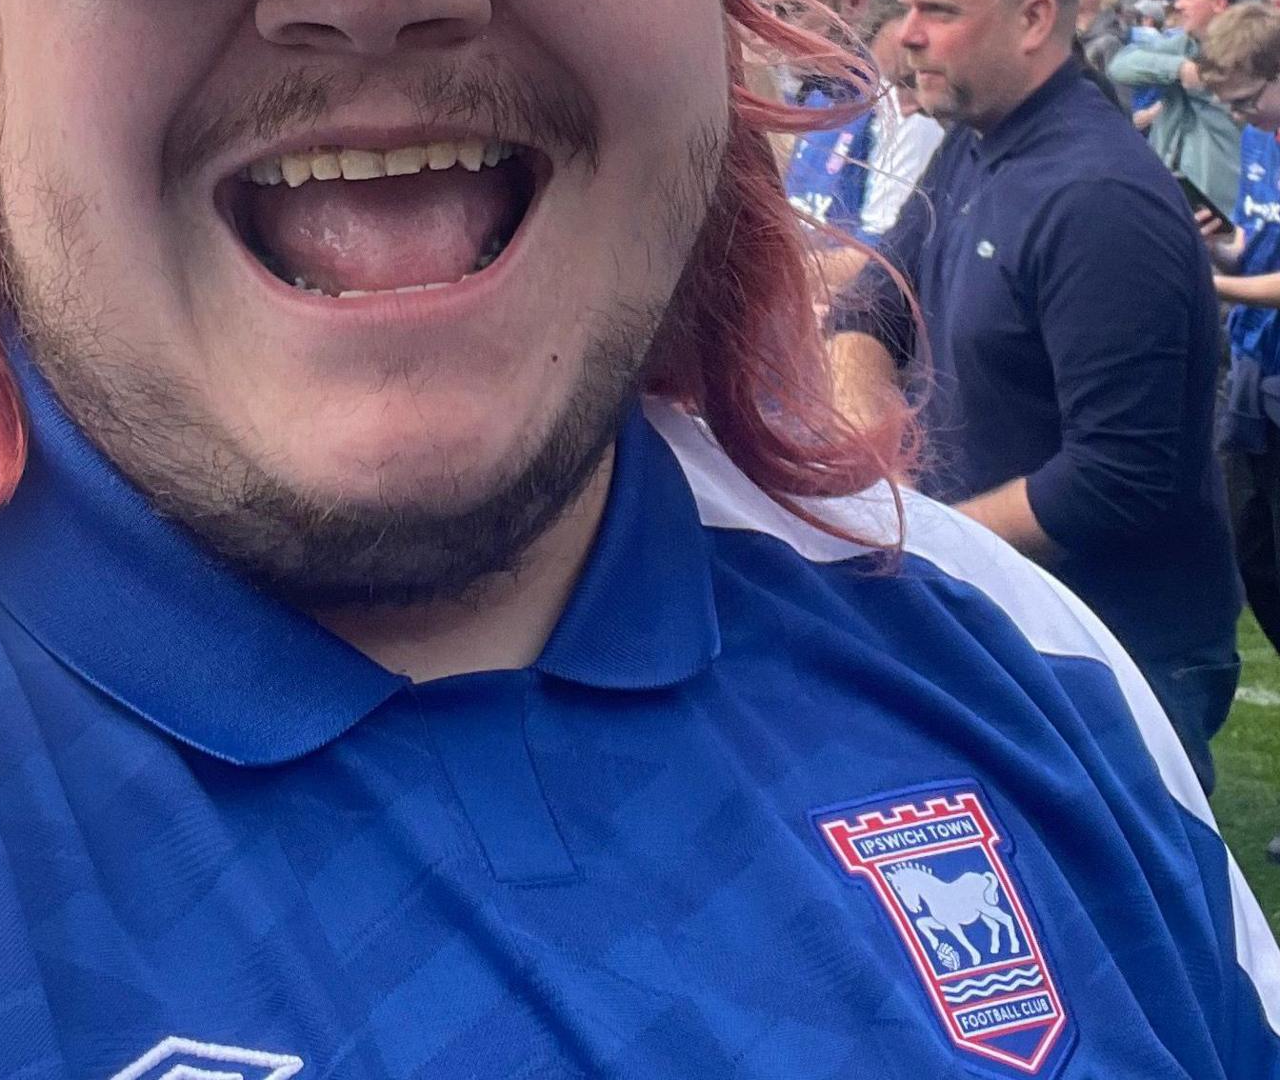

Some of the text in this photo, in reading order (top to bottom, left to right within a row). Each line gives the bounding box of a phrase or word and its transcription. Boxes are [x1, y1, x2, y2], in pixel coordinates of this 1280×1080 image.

[860, 819, 974, 855] IPSWICH TOWN
[961, 998, 1049, 1030] FOOTBALL CLUB
